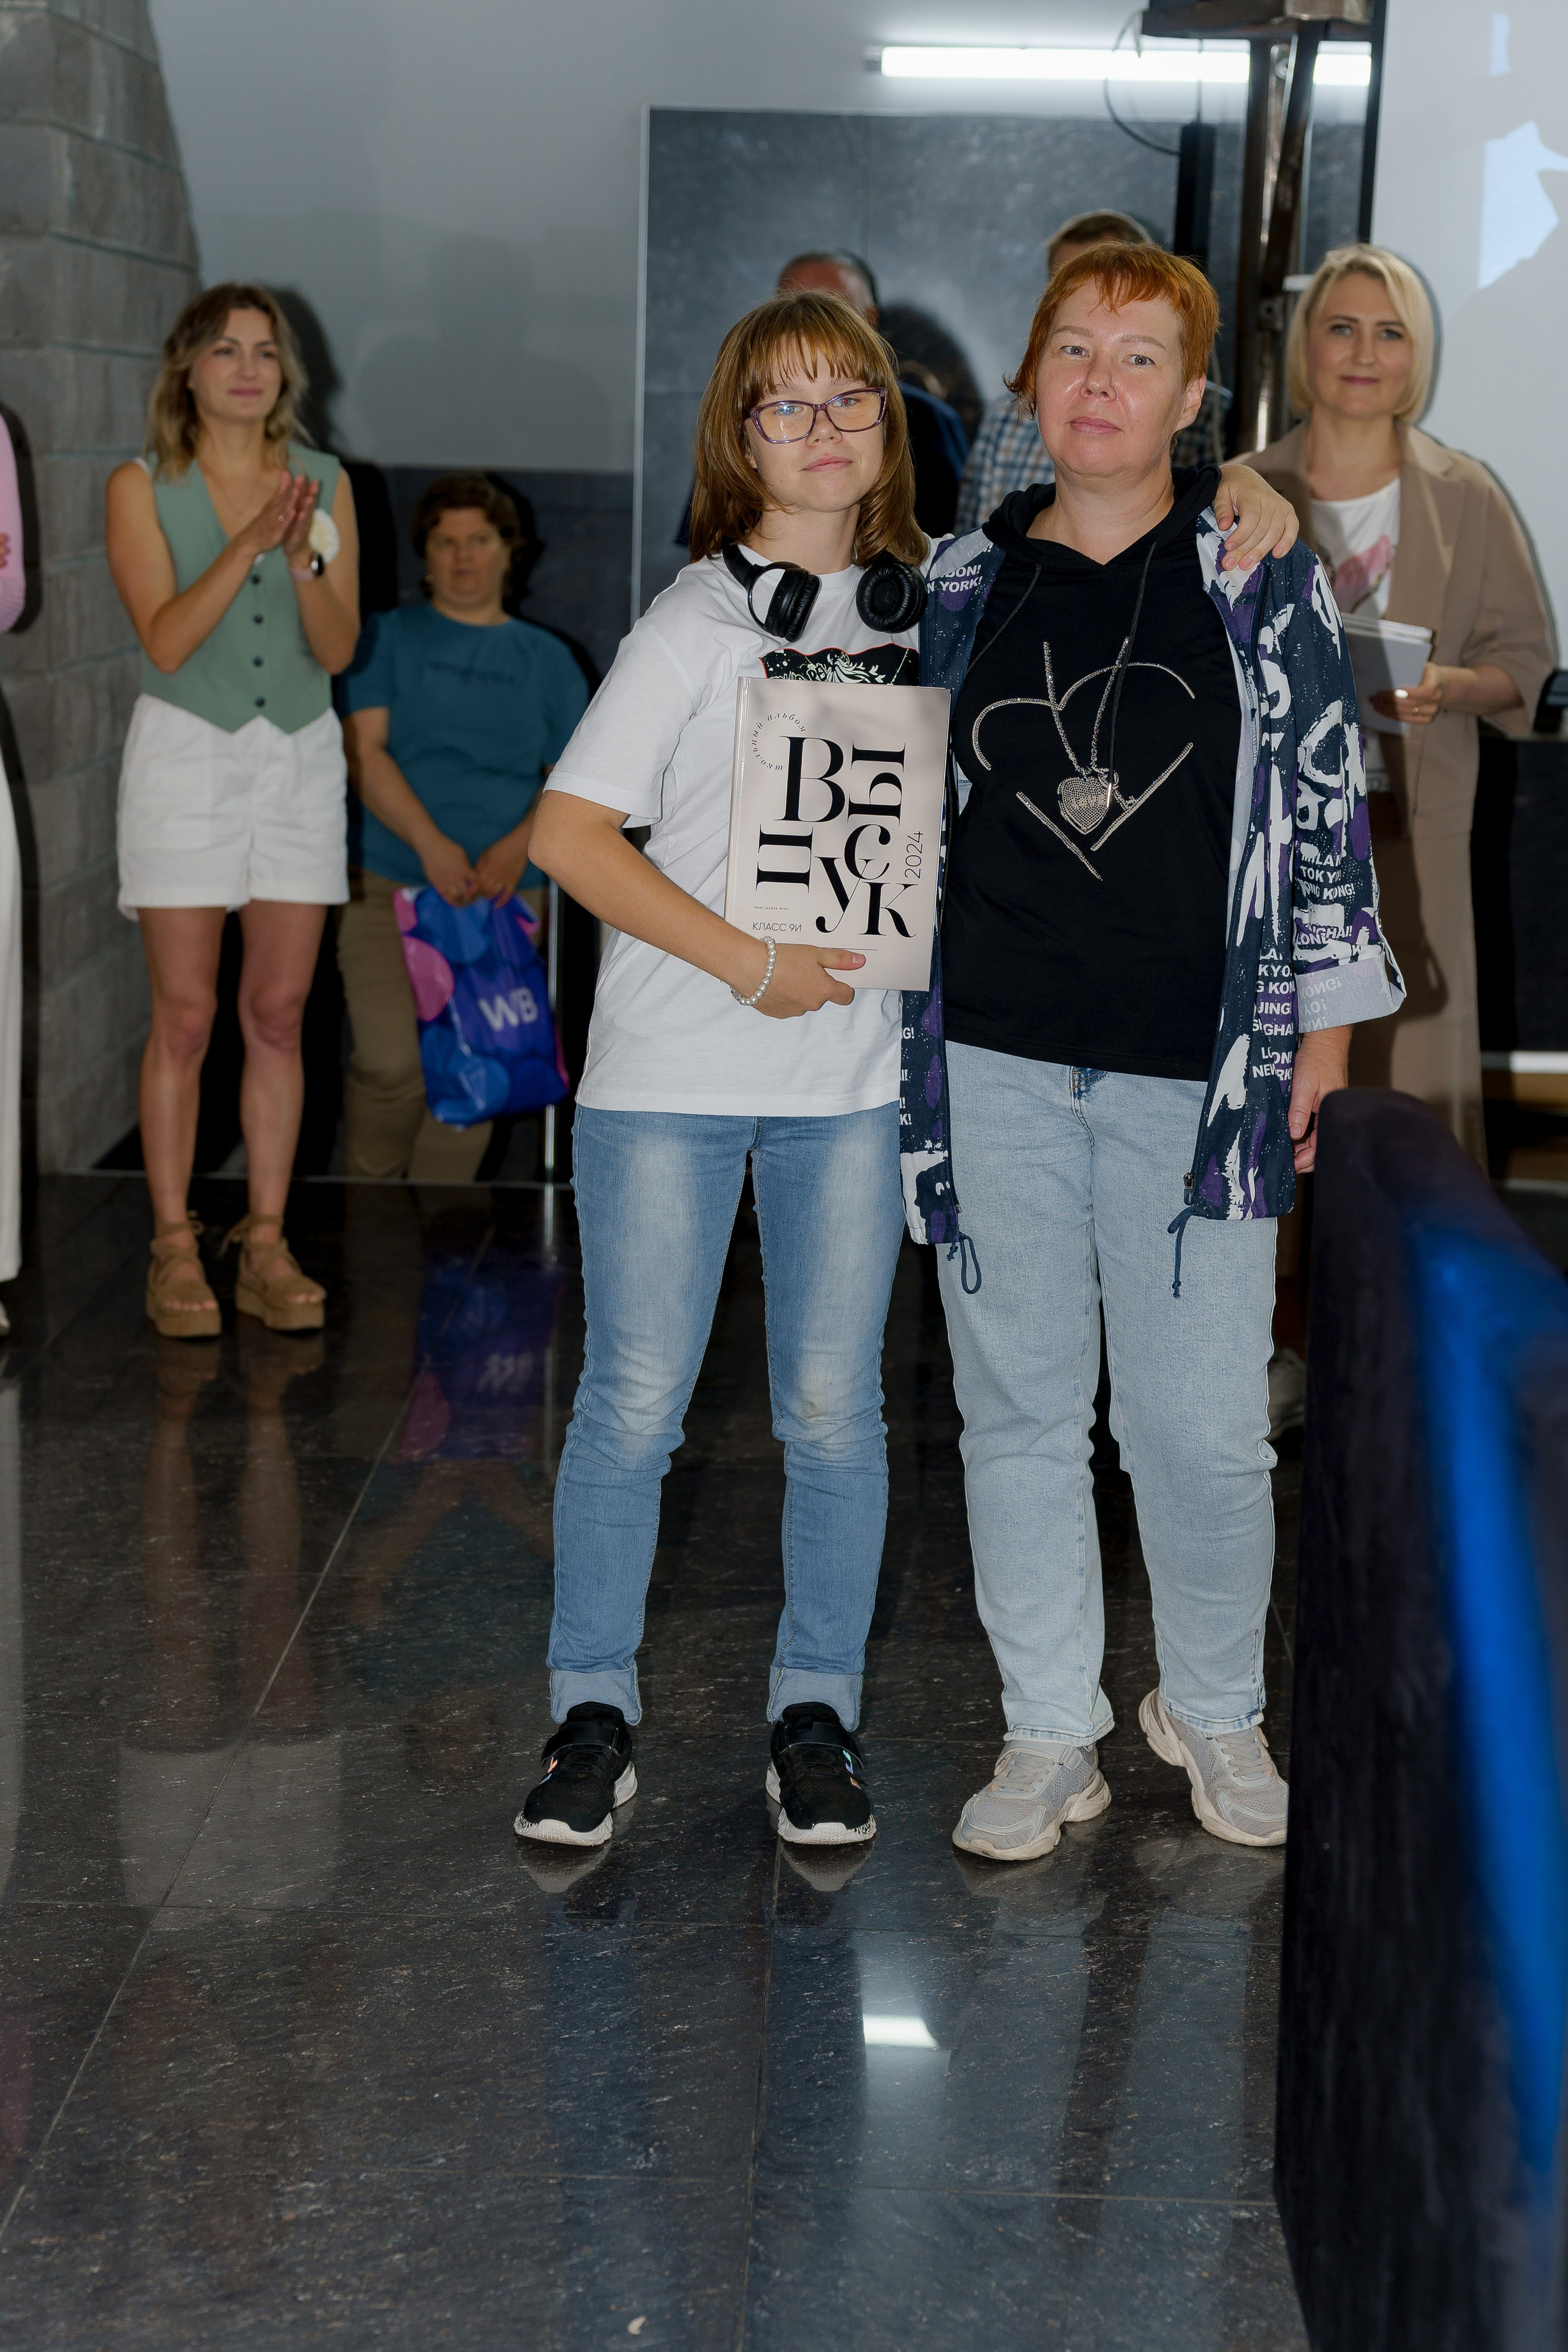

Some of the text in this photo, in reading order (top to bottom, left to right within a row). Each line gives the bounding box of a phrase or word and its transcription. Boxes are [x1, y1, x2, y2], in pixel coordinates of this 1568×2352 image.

[939, 565, 982, 578] DON!
[940, 576, 983, 593] YORK!
[767, 712, 806, 732] альбом
[904, 831, 924, 878] 2024
[1323, 883, 1355, 900] KONG!
[752, 922, 802, 932] КЛАСС 9И
[478, 988, 538, 1030] WB
[1257, 1001, 1292, 1015] JING!
